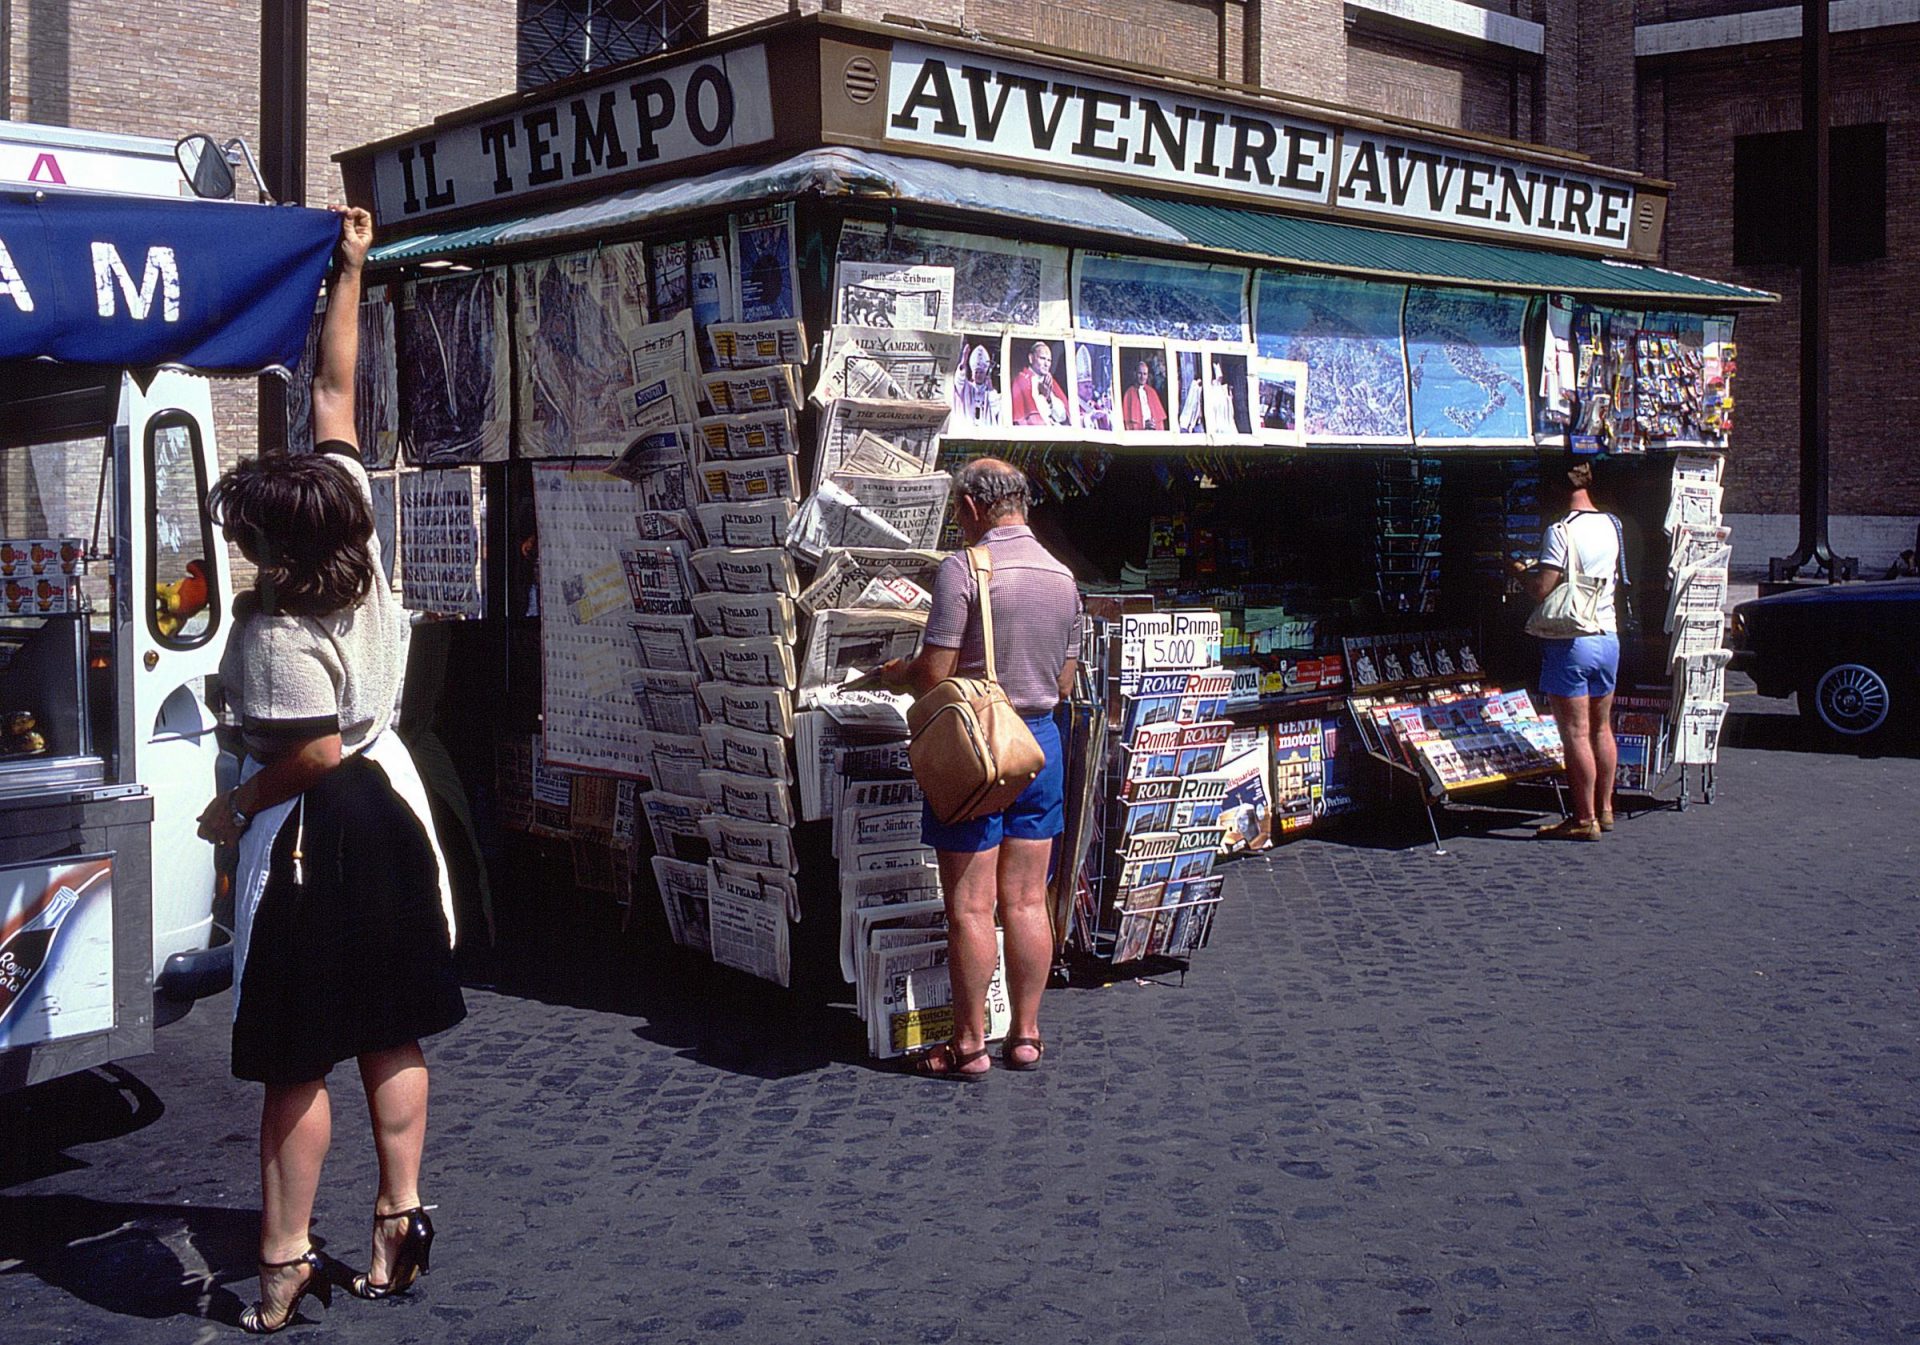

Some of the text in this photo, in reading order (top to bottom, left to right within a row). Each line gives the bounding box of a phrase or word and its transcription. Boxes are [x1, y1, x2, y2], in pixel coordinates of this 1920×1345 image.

[891, 59, 1327, 193] AVVENIRE
[399, 63, 734, 214] IL TEMPO
[1339, 140, 1631, 241] AVVENIRE
[903, 272, 936, 284] Tribune
[854, 341, 936, 352] AILY AMERICAN
[877, 411, 925, 420] GUARDIAN
[862, 484, 932, 492] SUNDAY EXPRESS
[873, 507, 911, 519] CHEAT
[912, 507, 926, 517] US
[874, 558, 925, 567] OBSERVER
[1153, 639, 1195, 664] 5.000
[1142, 675, 1187, 693] ROME
[1137, 731, 1177, 751] Roma
[1183, 726, 1228, 745] ROMA
[1137, 783, 1172, 799] ROM
[1129, 838, 1174, 858] Roma
[1179, 831, 1220, 849] ROMA
[0, 951, 31, 980] Royal
